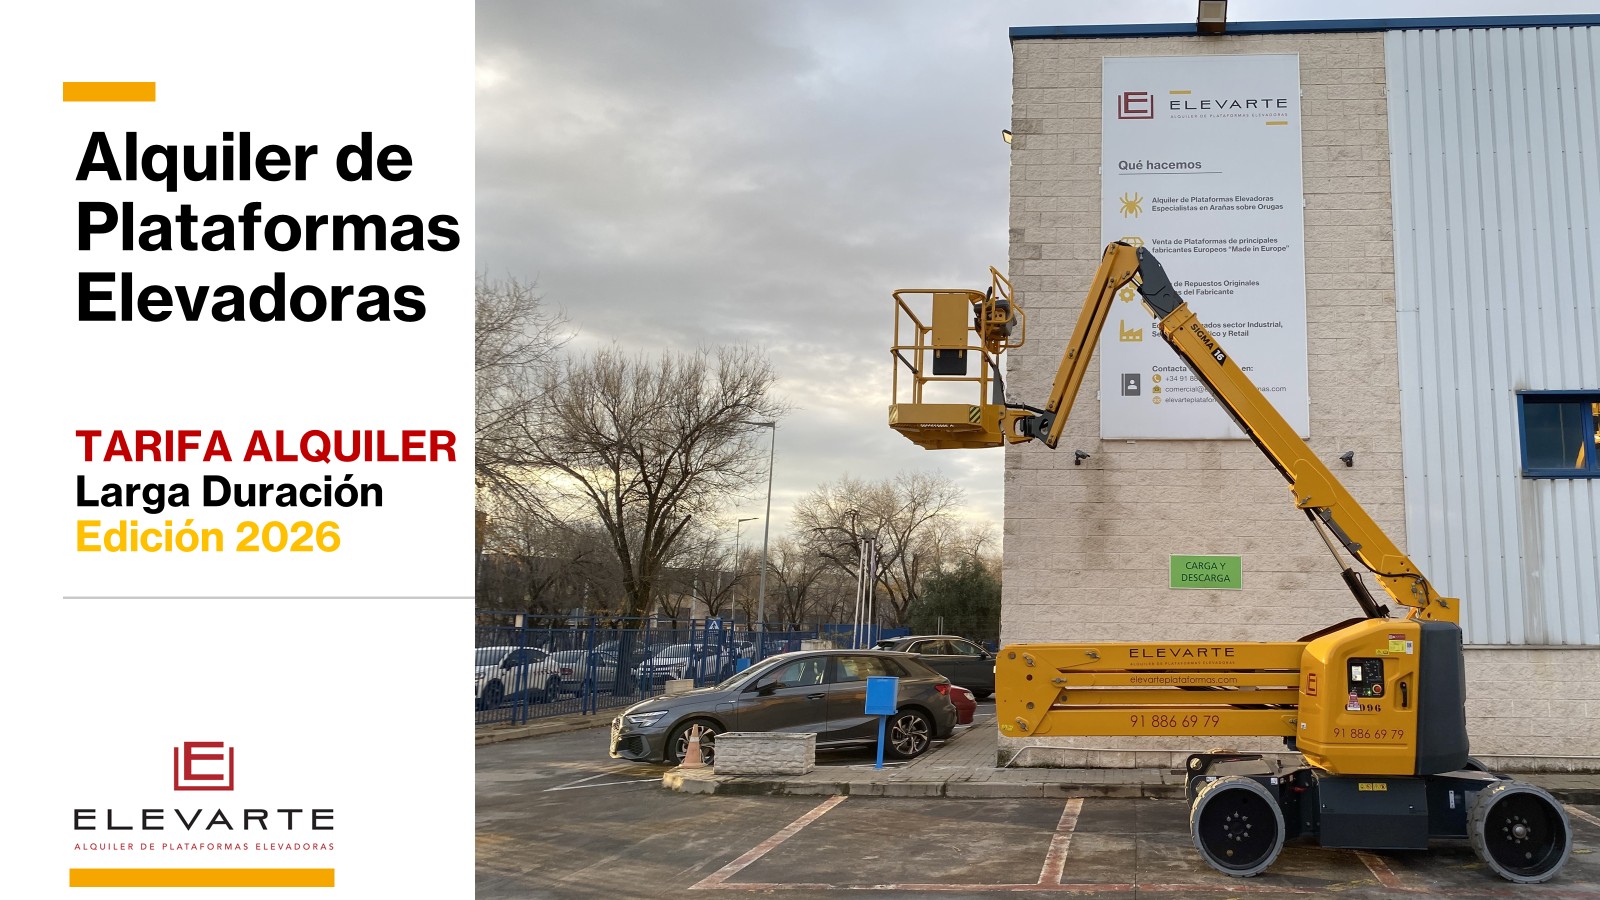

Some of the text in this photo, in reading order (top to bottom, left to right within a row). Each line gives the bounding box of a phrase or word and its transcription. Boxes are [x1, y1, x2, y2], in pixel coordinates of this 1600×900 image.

[1169, 98, 1288, 110] ELEVARTE
[1118, 159, 1202, 171] Qué hacemos
[1257, 203, 1284, 211] Orugas
[1238, 237, 1278, 245] principales
[1193, 246, 1227, 254] Europeos
[1184, 280, 1222, 288] Repuestos
[1223, 279, 1260, 288] Originales
[1183, 288, 1195, 296] del
[1195, 288, 1234, 296] Fabricante
[1247, 320, 1283, 329] Industrial,
[1190, 323, 1214, 350] SIGMA
[1213, 349, 1225, 361] 16
[1185, 561, 1226, 570] CARGA Y
[1181, 573, 1231, 583] DESCARGA
[1129, 647, 1235, 658] ELEVARTE
[1130, 675, 1238, 685] elevarteplataformas.com
[1130, 714, 1220, 728] 91 886 69 79
[1333, 727, 1404, 740] 91 886 69 79
